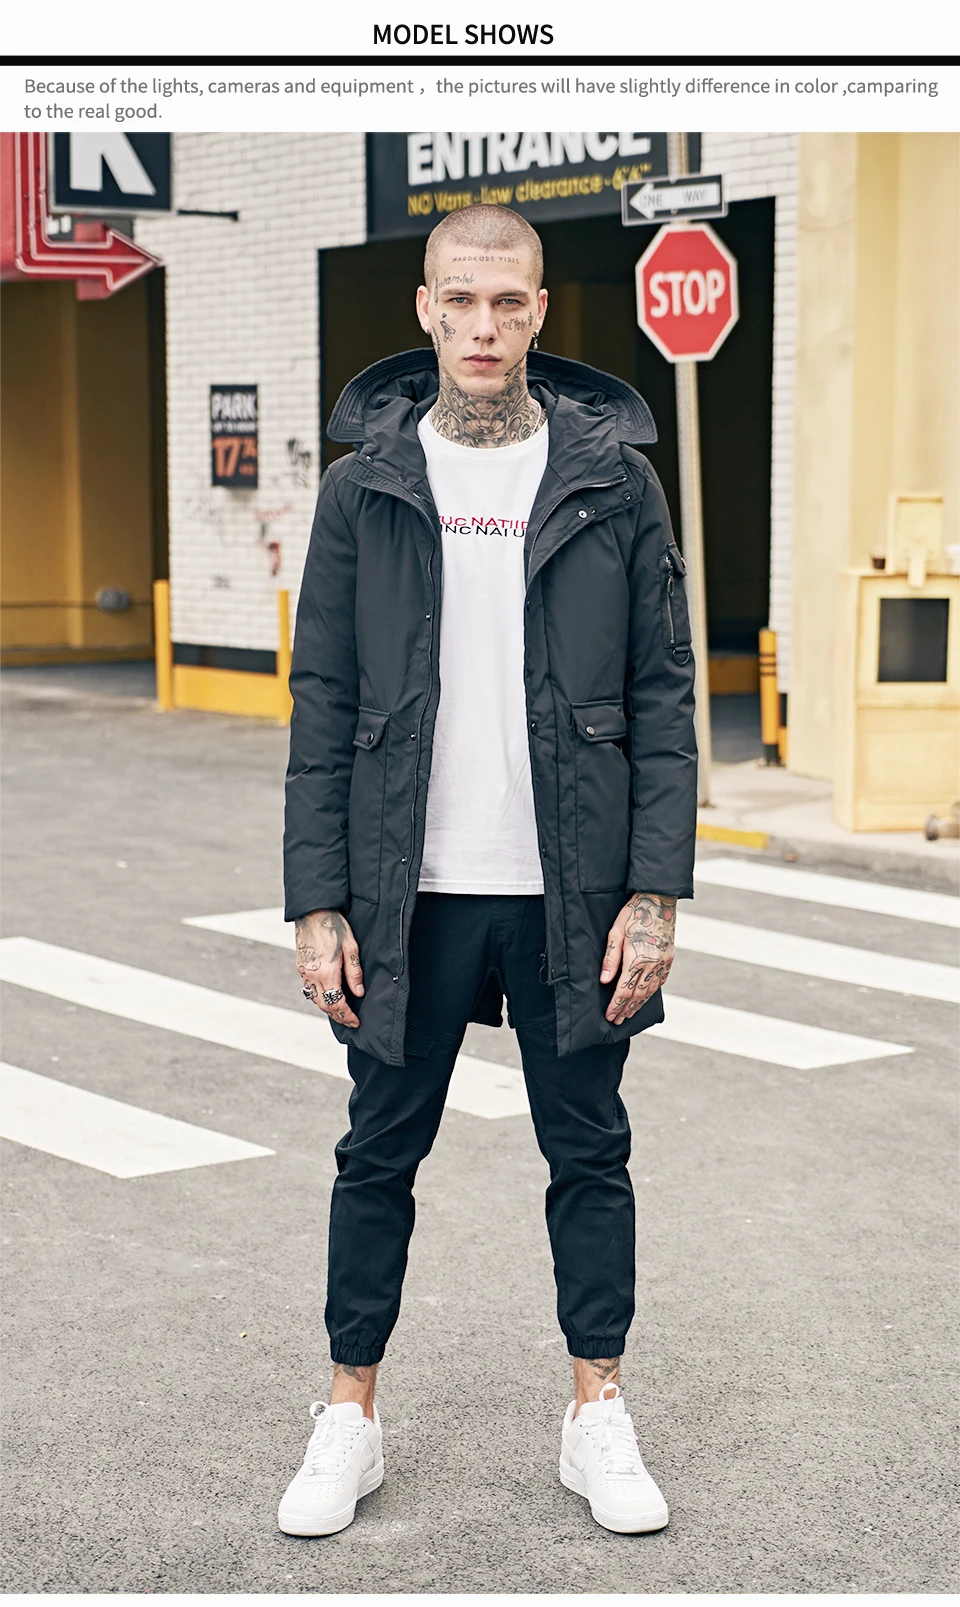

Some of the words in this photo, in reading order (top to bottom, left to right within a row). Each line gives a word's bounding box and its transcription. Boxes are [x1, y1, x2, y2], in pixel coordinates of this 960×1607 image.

[408, 192, 434, 217] NO
[515, 174, 604, 203] clearance
[640, 193, 664, 209] ONE
[682, 187, 708, 204] WAY
[650, 269, 726, 318] STOP
[211, 391, 257, 420] PARK
